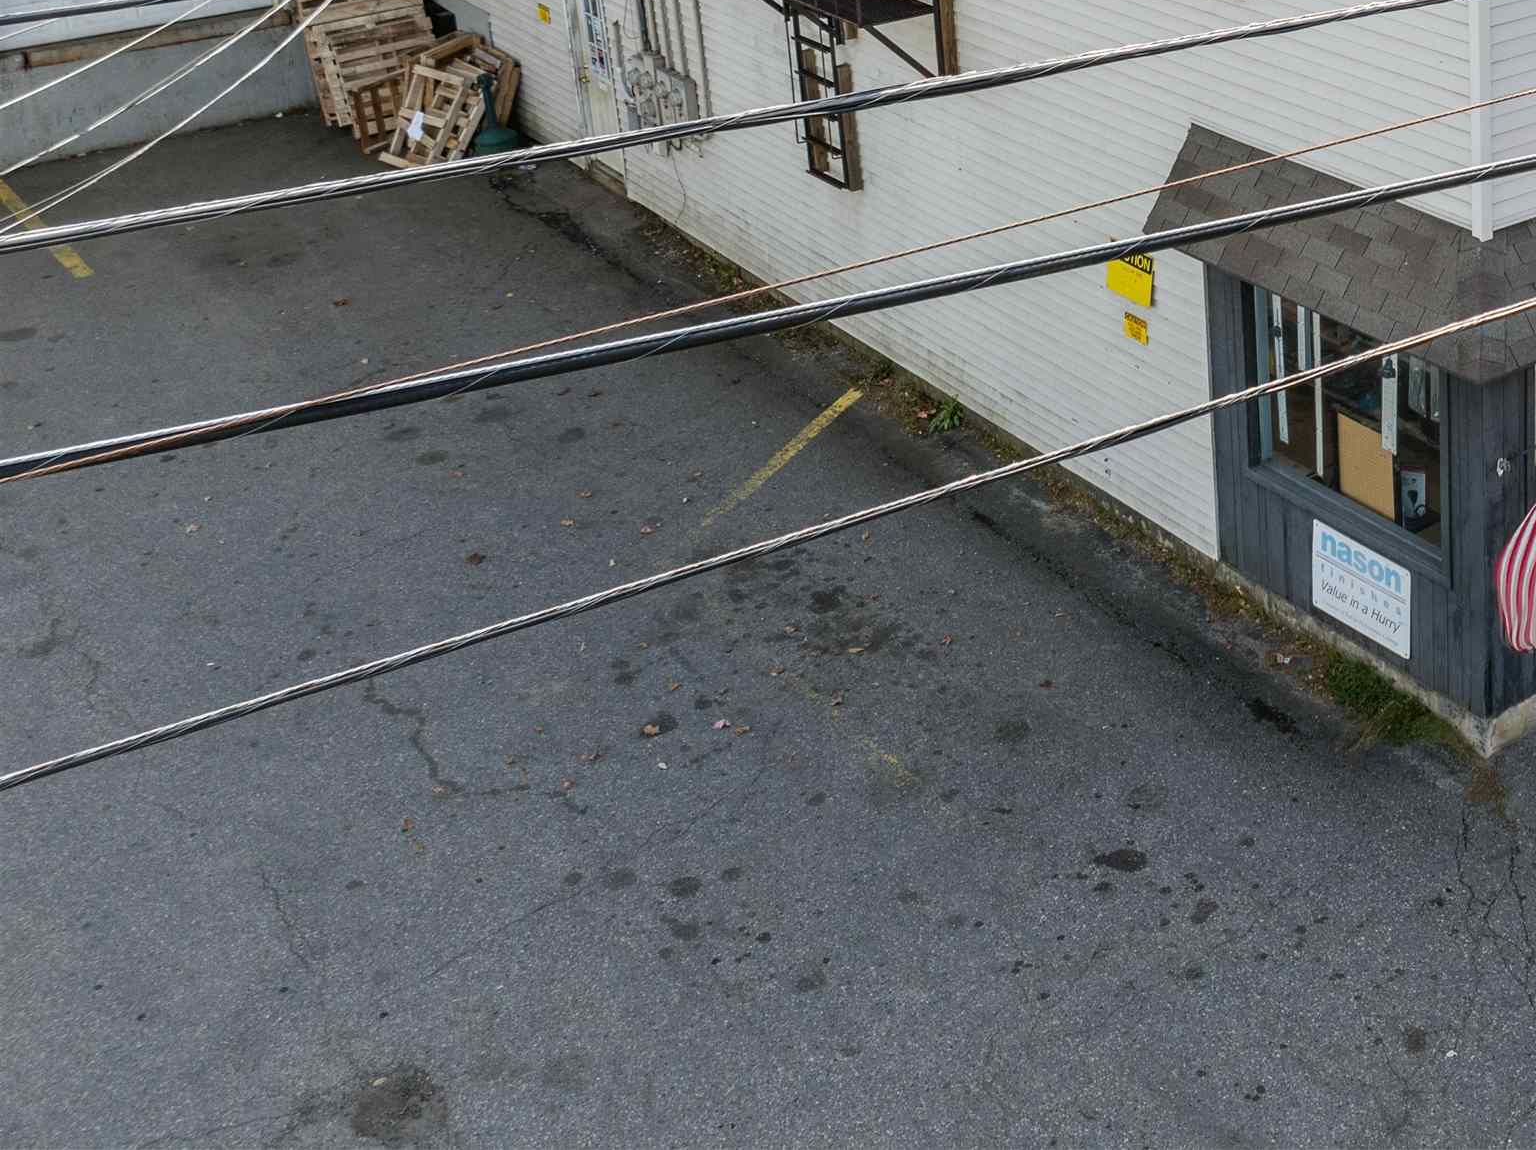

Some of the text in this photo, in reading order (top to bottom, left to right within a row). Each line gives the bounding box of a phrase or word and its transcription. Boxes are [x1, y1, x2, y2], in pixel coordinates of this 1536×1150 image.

[1320, 531, 1402, 594] nason
[1320, 578, 1348, 604] Value
[1350, 595, 1360, 611] in
[1361, 604, 1370, 615] a
[1371, 608, 1401, 634] Hurry
